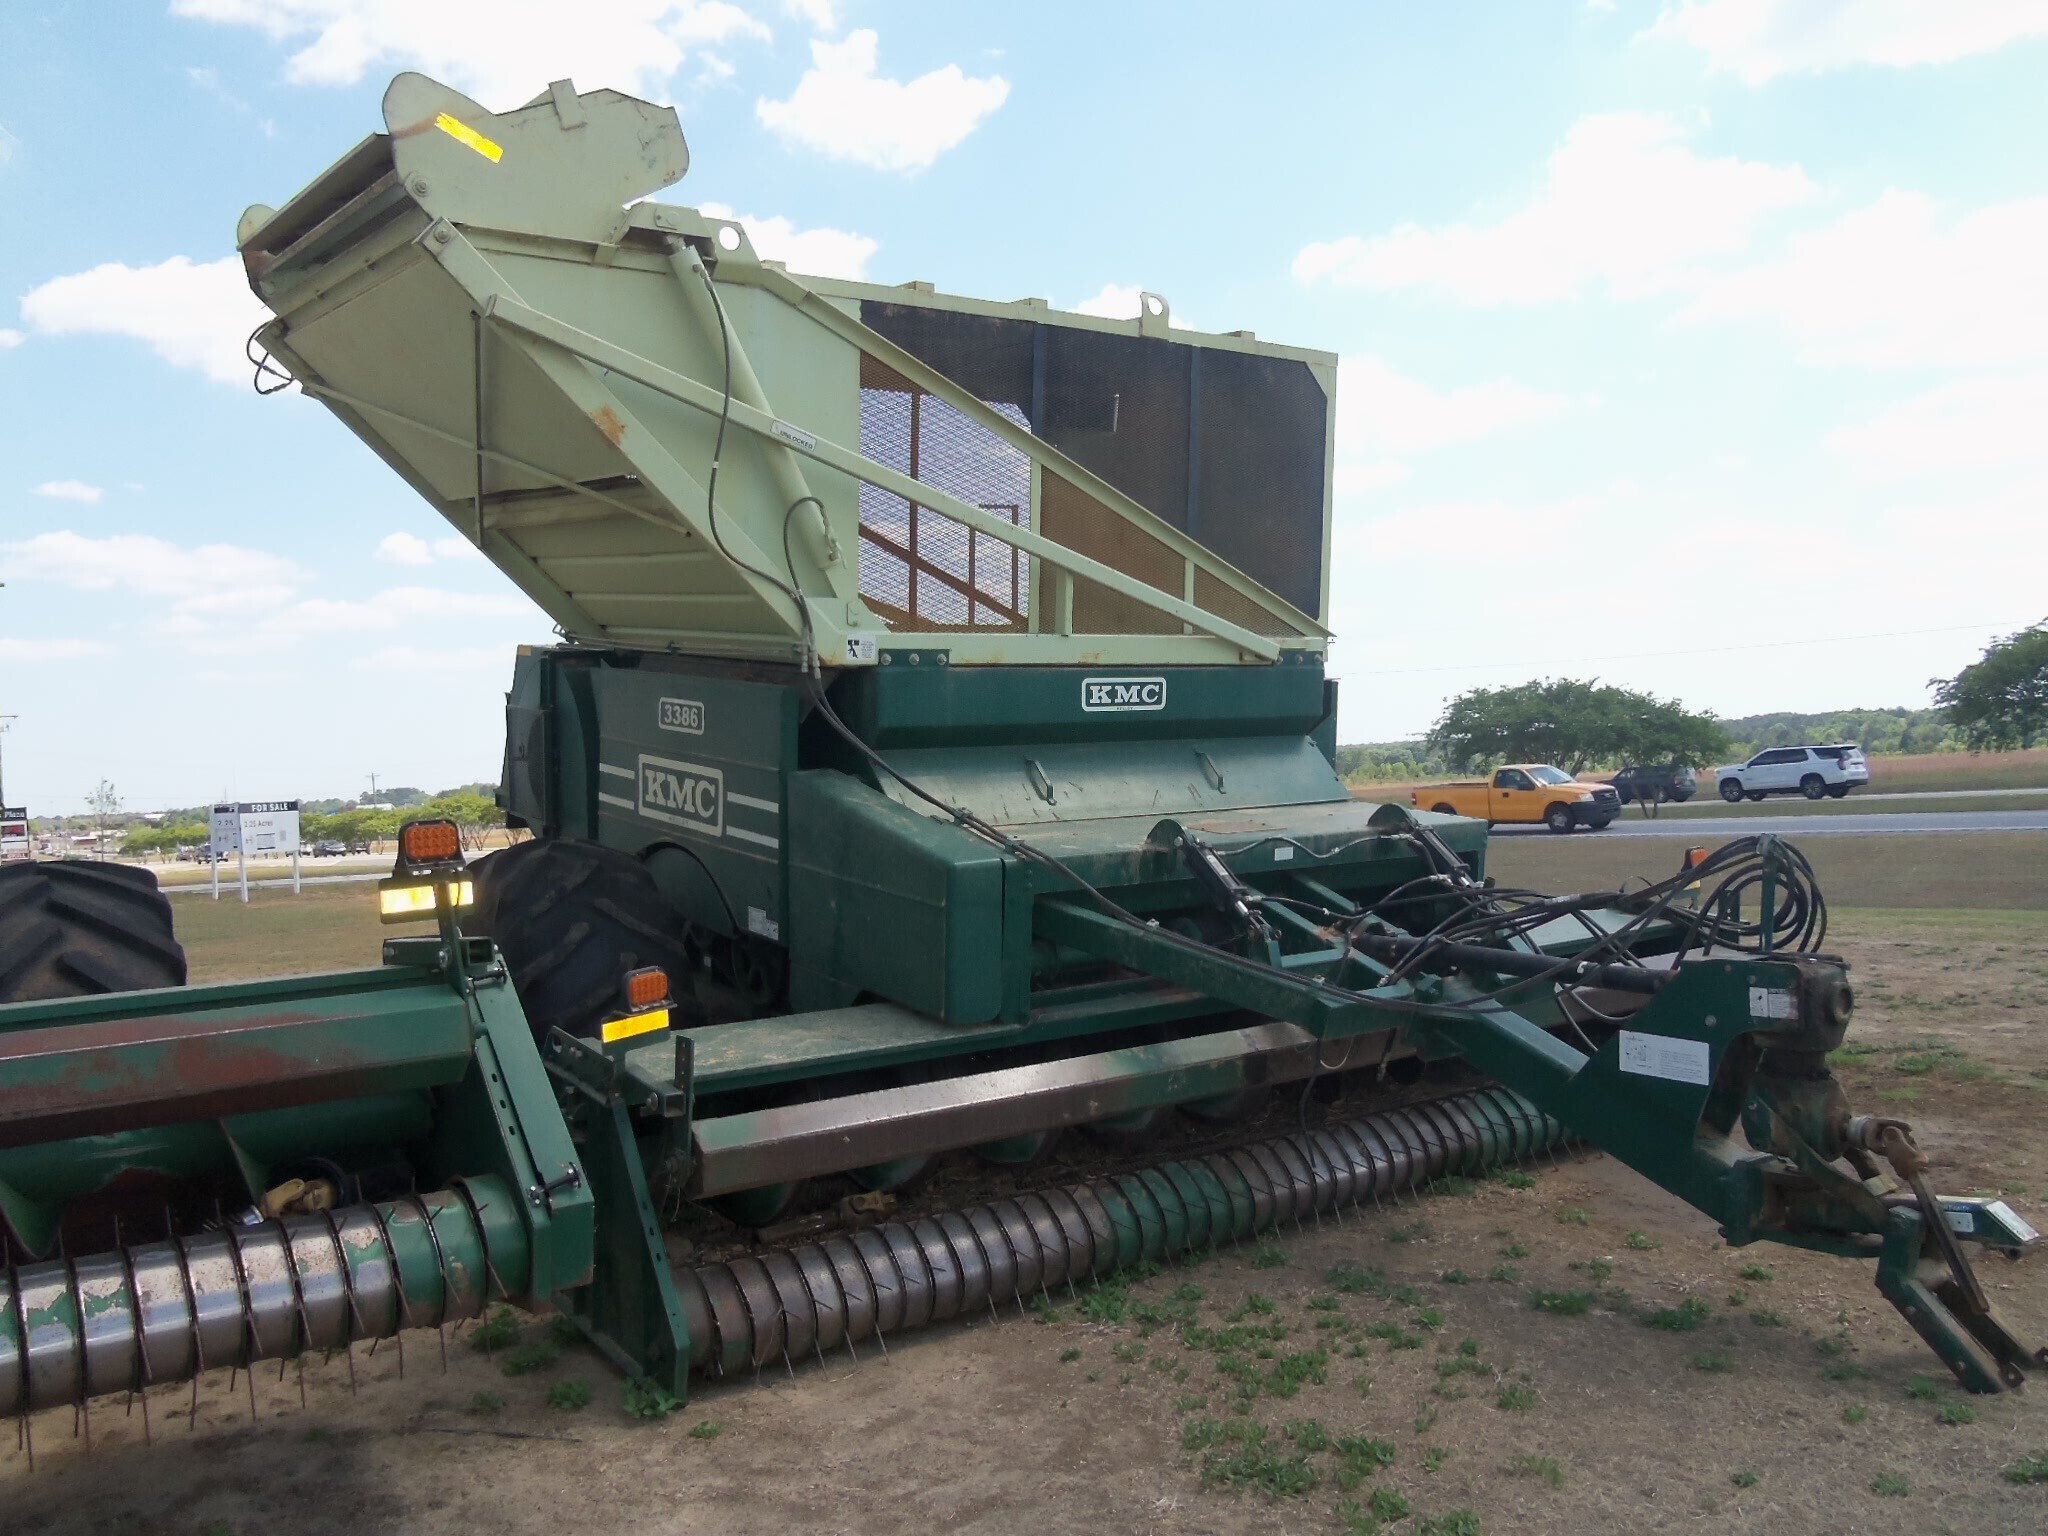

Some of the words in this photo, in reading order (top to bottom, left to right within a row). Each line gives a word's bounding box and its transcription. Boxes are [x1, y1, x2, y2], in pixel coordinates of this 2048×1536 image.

[1089, 684, 1160, 704] KMC
[664, 704, 699, 728] 3386
[644, 769, 716, 818] KMC
[252, 804, 268, 812] FOR
[269, 803, 289, 811] SALE
